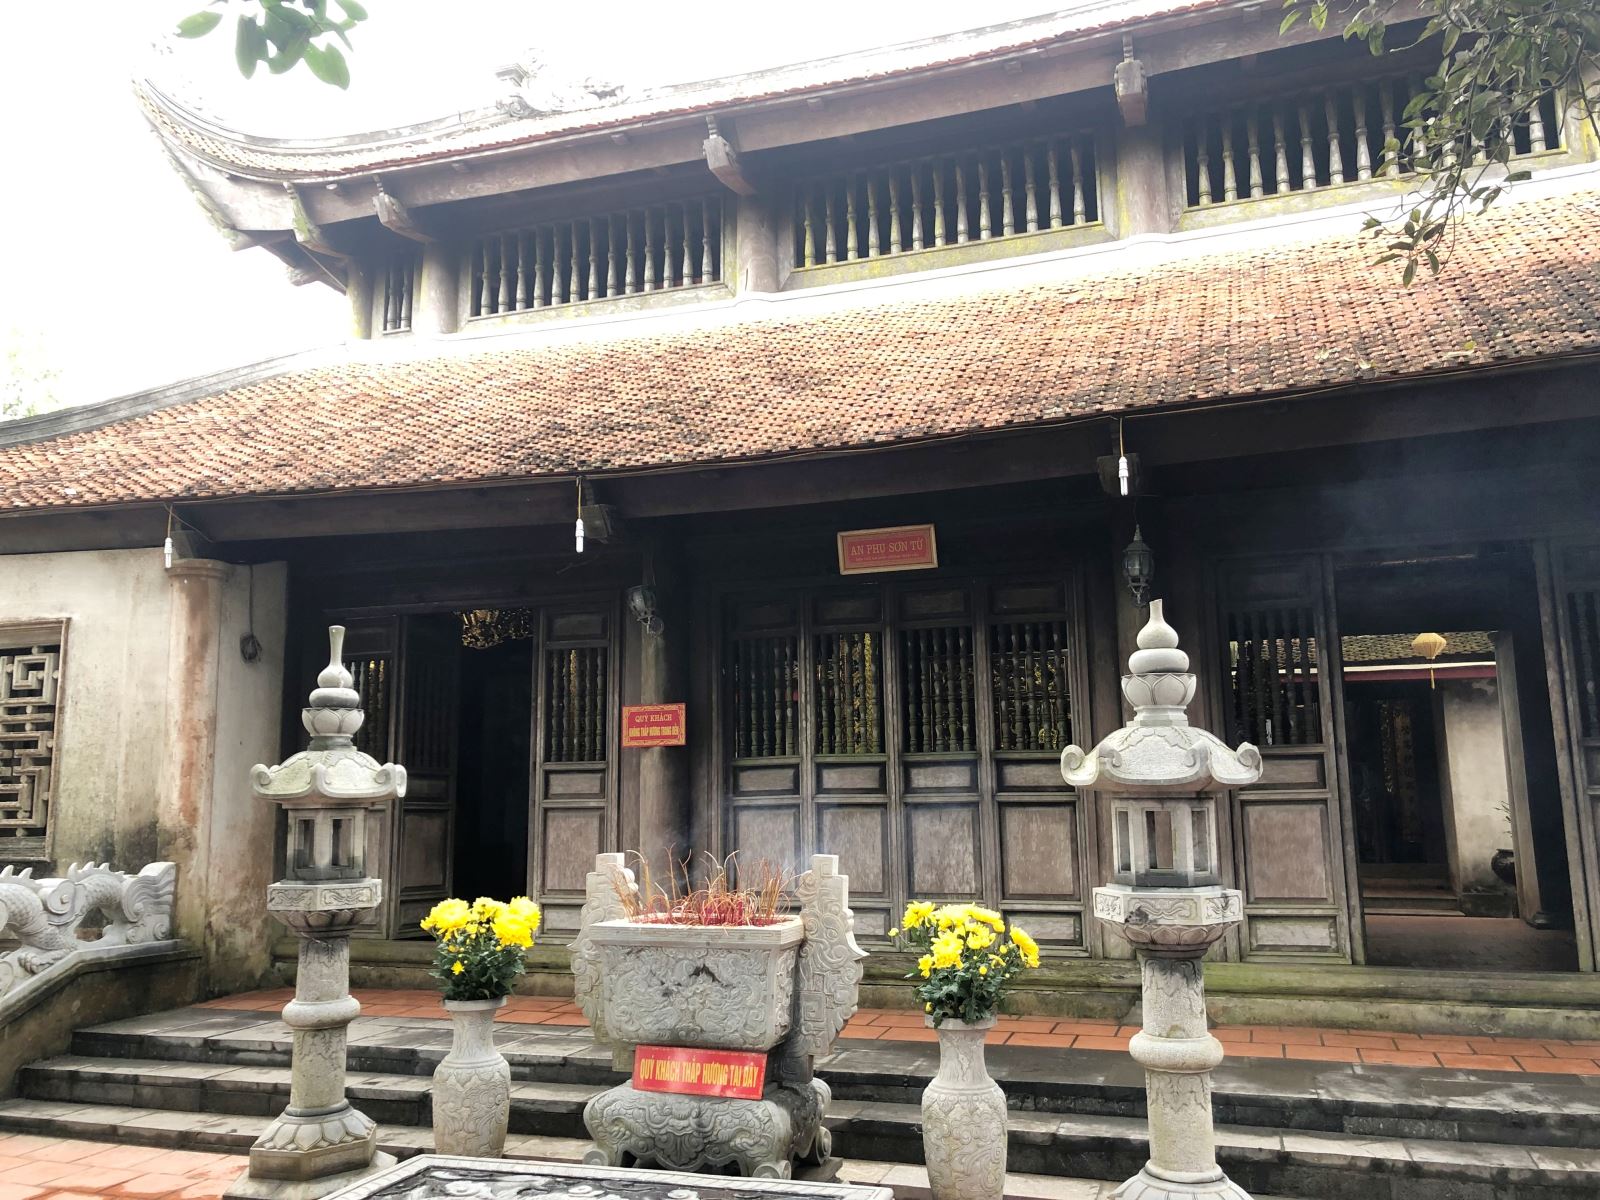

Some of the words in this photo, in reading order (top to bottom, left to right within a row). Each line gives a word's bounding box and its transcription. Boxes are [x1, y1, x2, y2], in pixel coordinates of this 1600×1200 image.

[851, 545, 864, 556] AN
[888, 541, 908, 552] SƠN
[635, 713, 648, 722] QUÝ
[650, 713, 672, 721] KHÁCH
[639, 1055, 655, 1082] QUÝ
[655, 1056, 681, 1082] KHÁCH
[682, 1056, 701, 1083] THẮP
[702, 1061, 728, 1086] HƯƠNG
[730, 1064, 742, 1092] TẠI
[743, 1061, 759, 1087] ĐÂY
